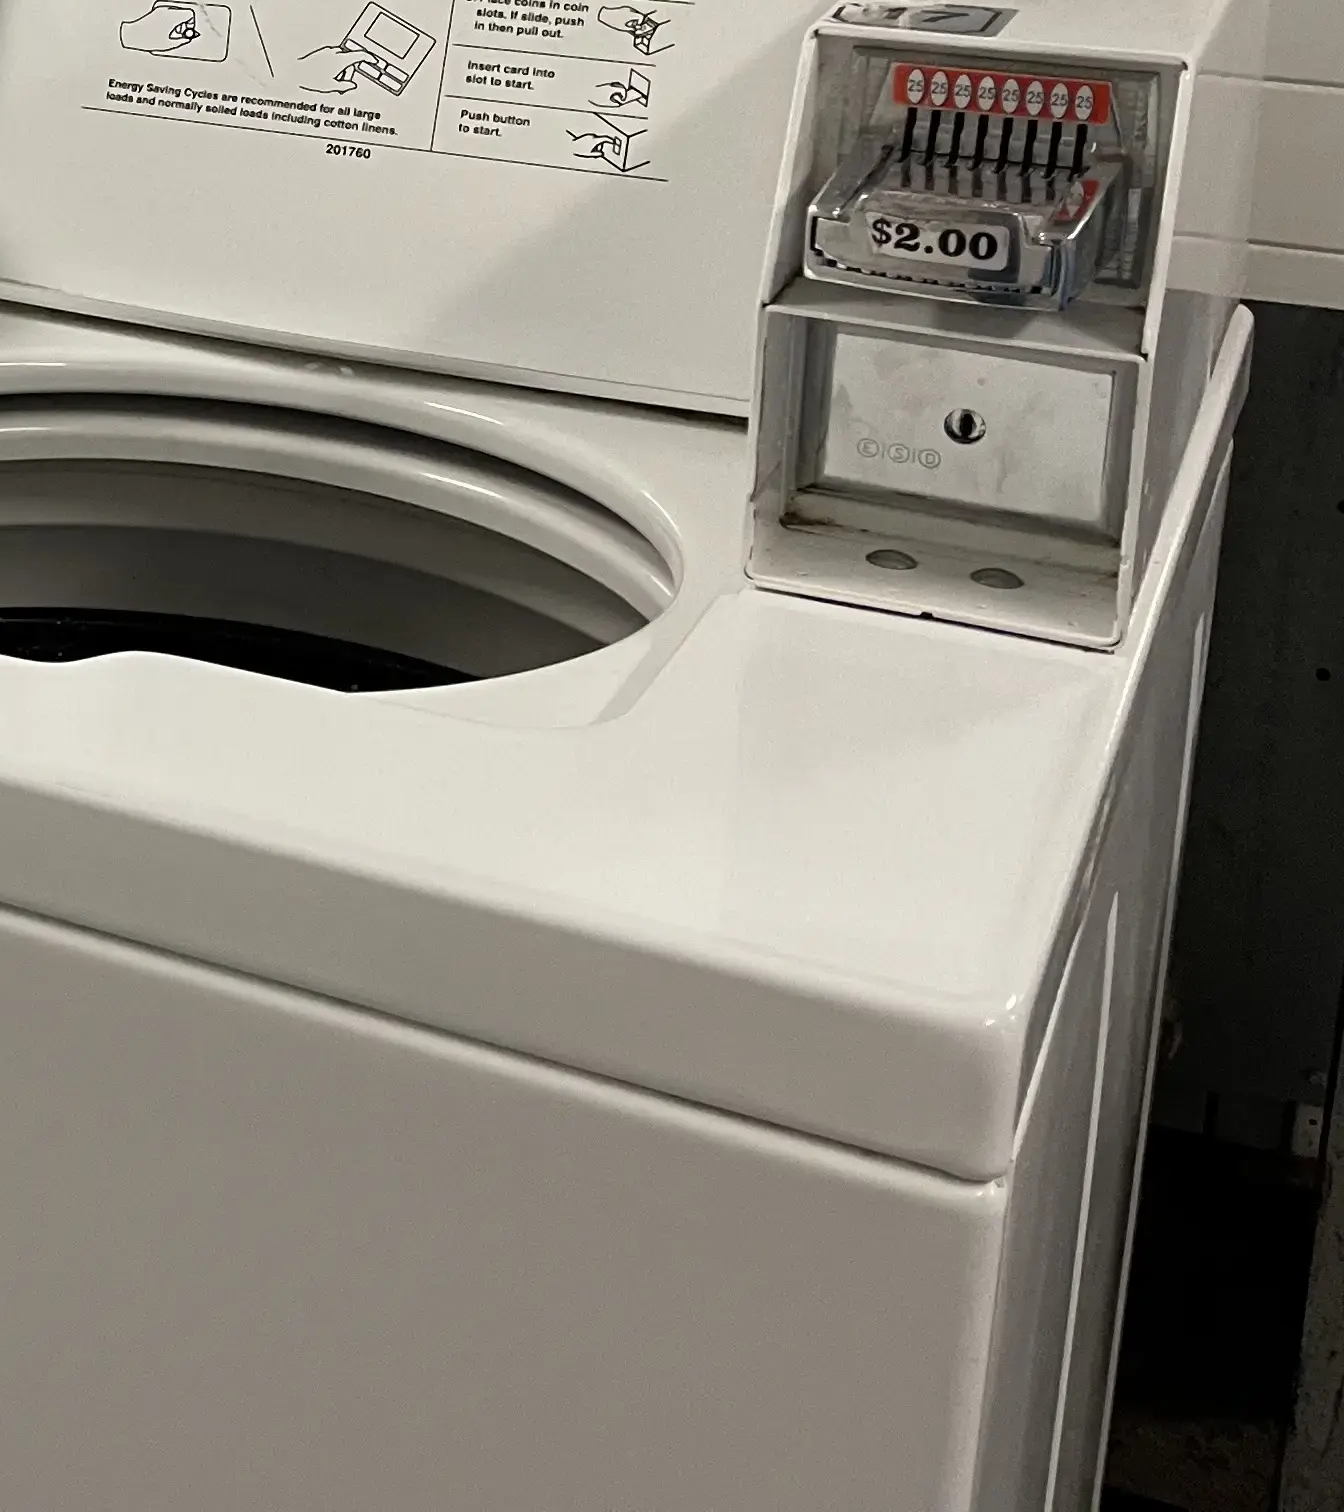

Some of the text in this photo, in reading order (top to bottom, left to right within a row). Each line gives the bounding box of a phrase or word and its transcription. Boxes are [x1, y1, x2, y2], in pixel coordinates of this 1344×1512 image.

[467, 60, 555, 78] Insert card into
[465, 74, 534, 90] slot to start.
[909, 79, 1092, 108] 25 25 25 25 25 25 25 25
[460, 109, 530, 126] Push button
[458, 123, 501, 136] to start.
[325, 144, 370, 159] 201760
[872, 219, 998, 261] $2.00
